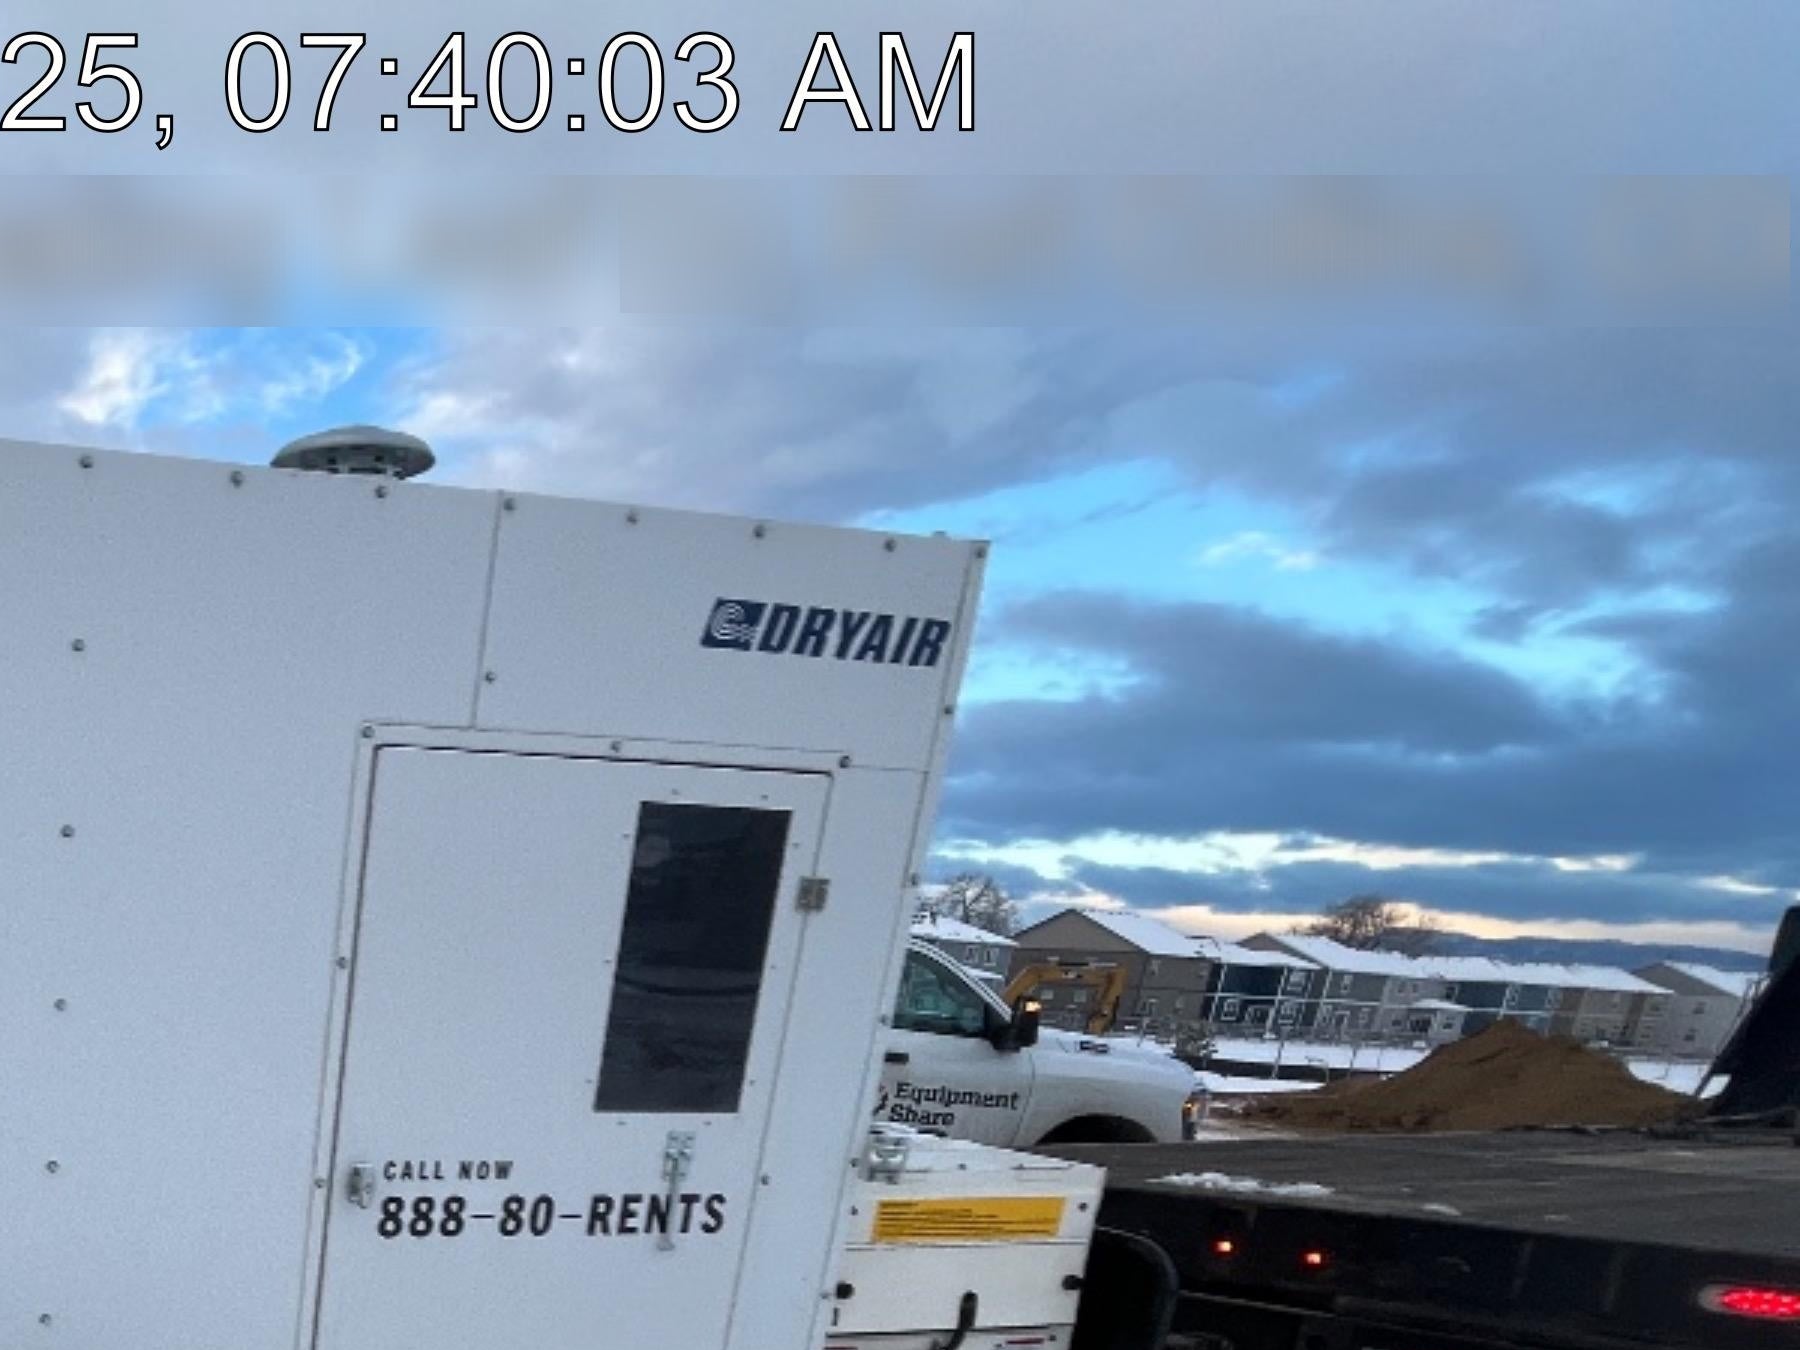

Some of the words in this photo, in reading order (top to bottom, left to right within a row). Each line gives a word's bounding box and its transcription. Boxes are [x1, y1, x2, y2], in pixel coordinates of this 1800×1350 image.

[758, 602, 951, 667] DRYAIR
[894, 1081, 1019, 1110] Equipment
[888, 1103, 954, 1126] Share
[383, 1160, 445, 1181] CALL
[458, 1160, 514, 1181] NOW
[377, 1193, 727, 1238] 888-80-RENTS
